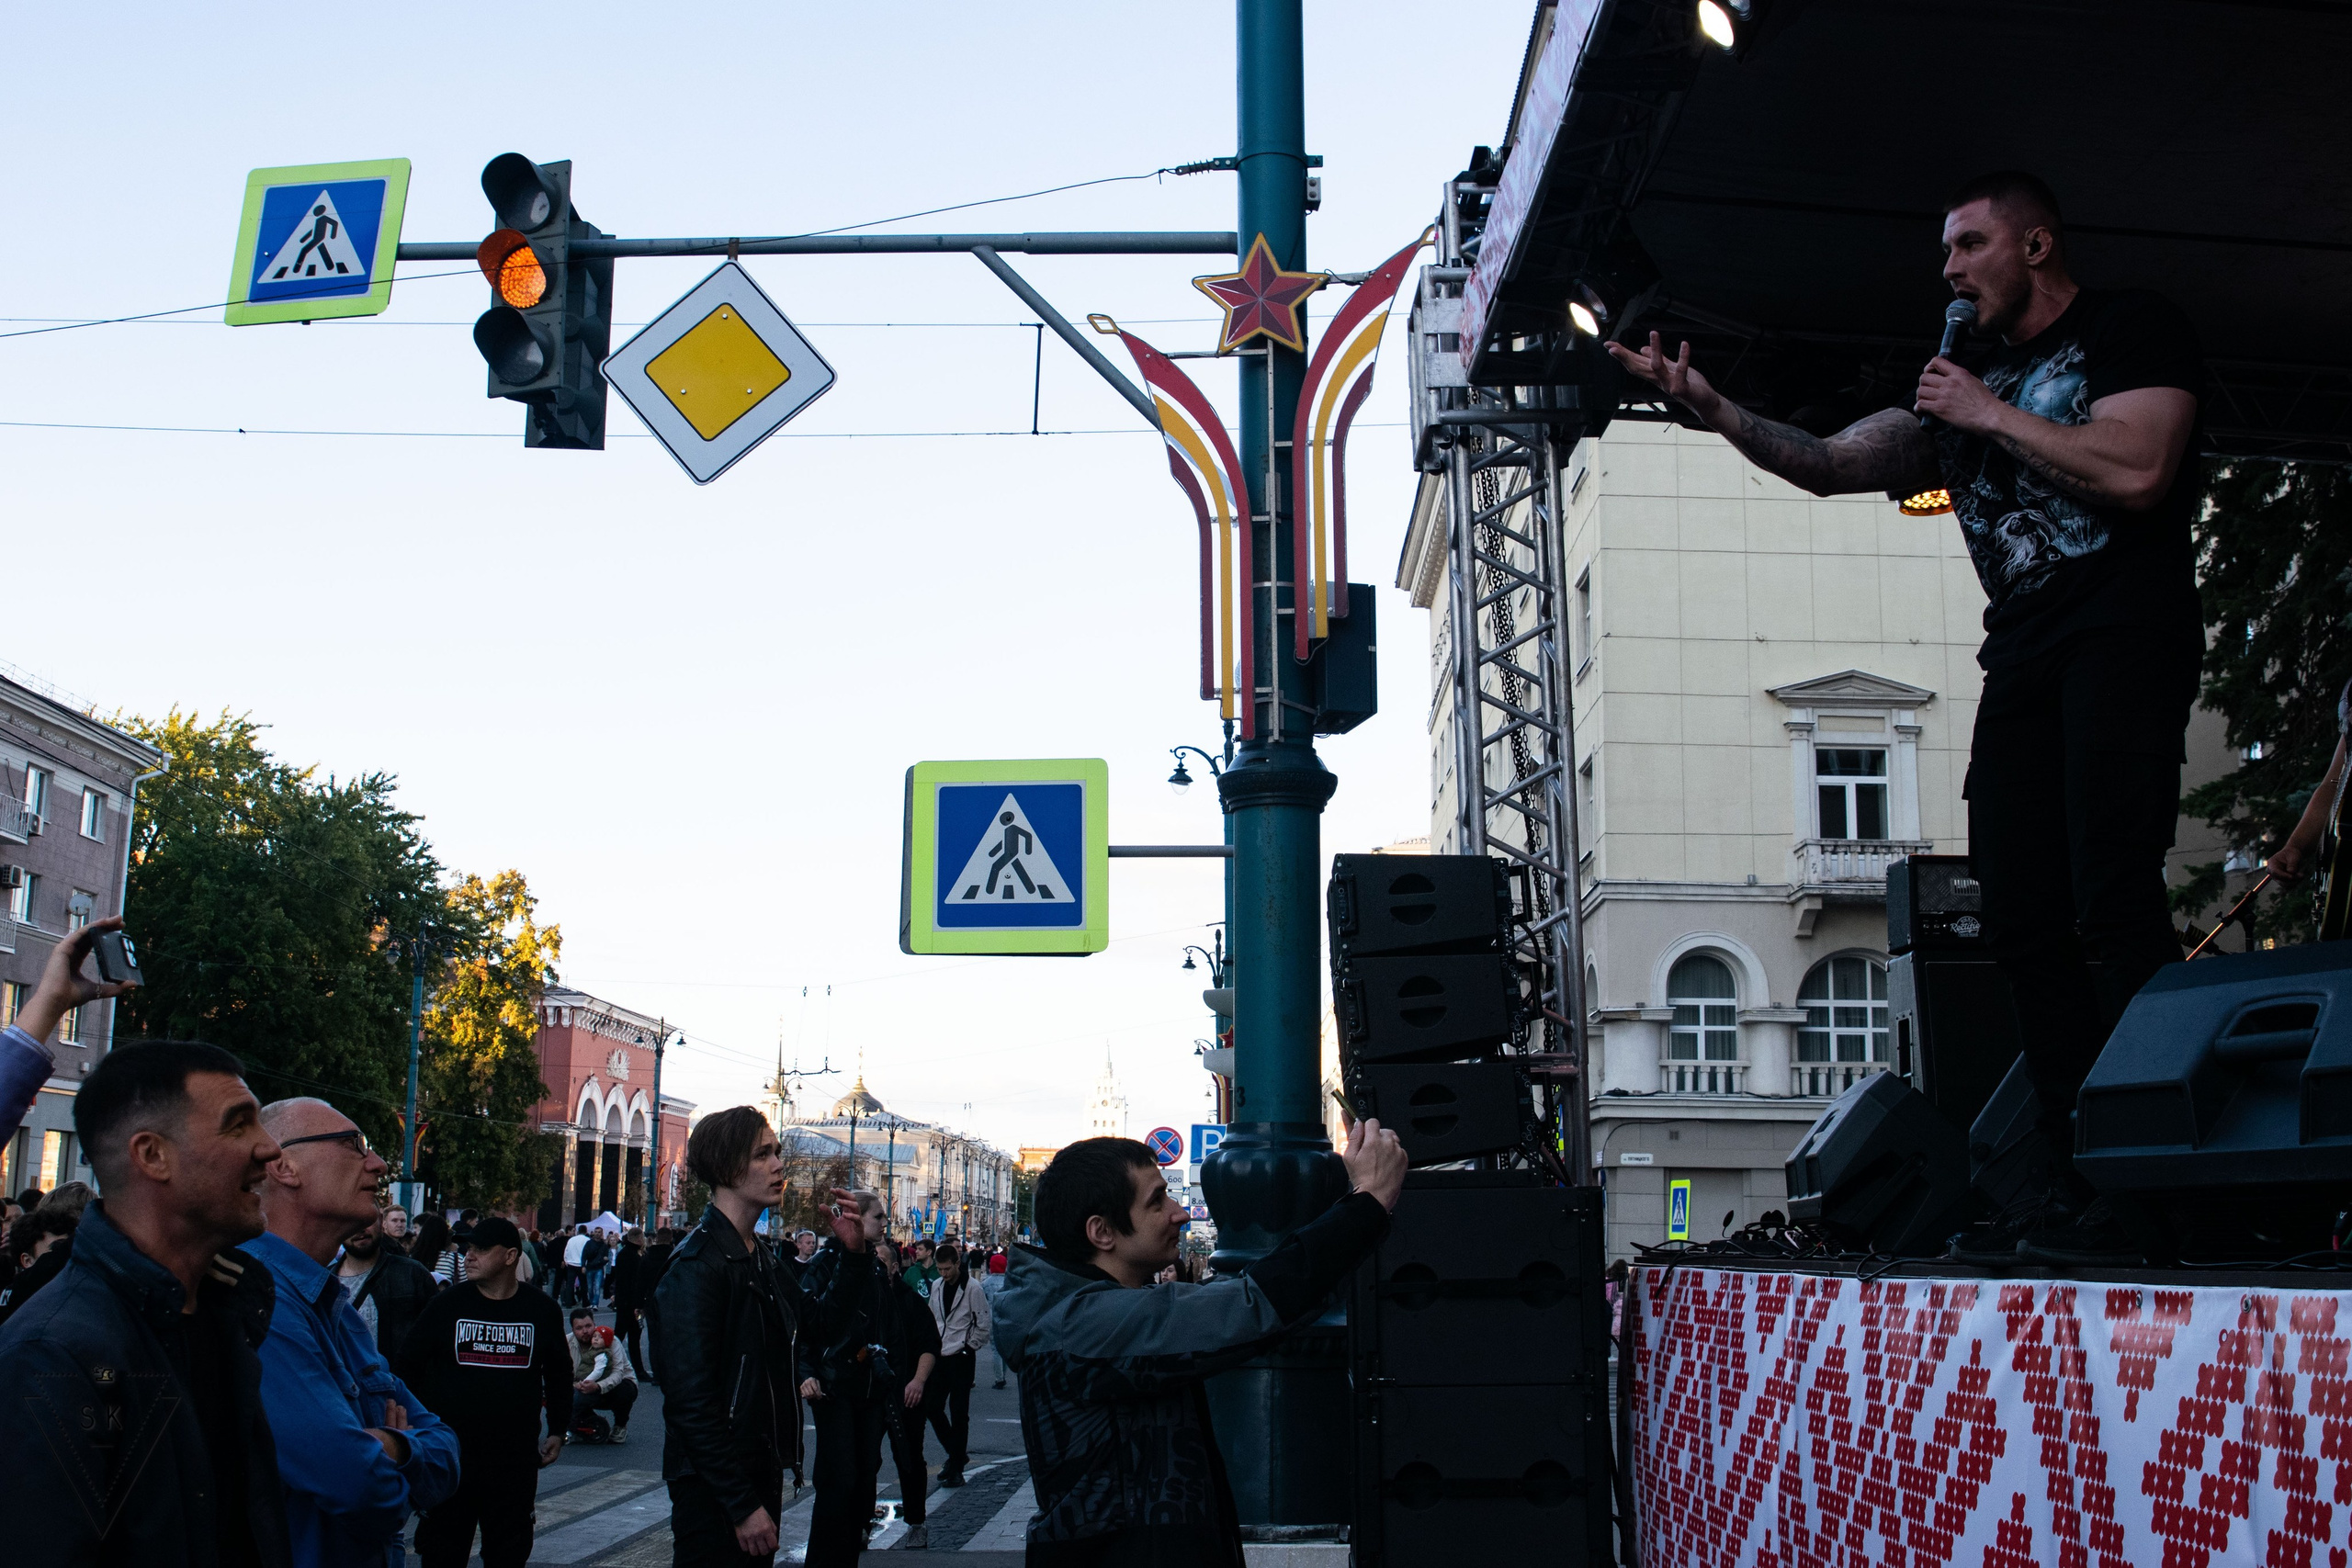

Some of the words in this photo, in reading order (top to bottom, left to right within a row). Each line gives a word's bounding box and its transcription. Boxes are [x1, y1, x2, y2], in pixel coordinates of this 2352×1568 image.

[1950, 921, 1981, 933] Rectifie
[1202, 1129, 1224, 1160] P
[458, 1323, 484, 1343] MOVE
[485, 1325, 531, 1348] FORWARD
[473, 1343, 494, 1353] SINCE
[495, 1345, 516, 1354] 2006
